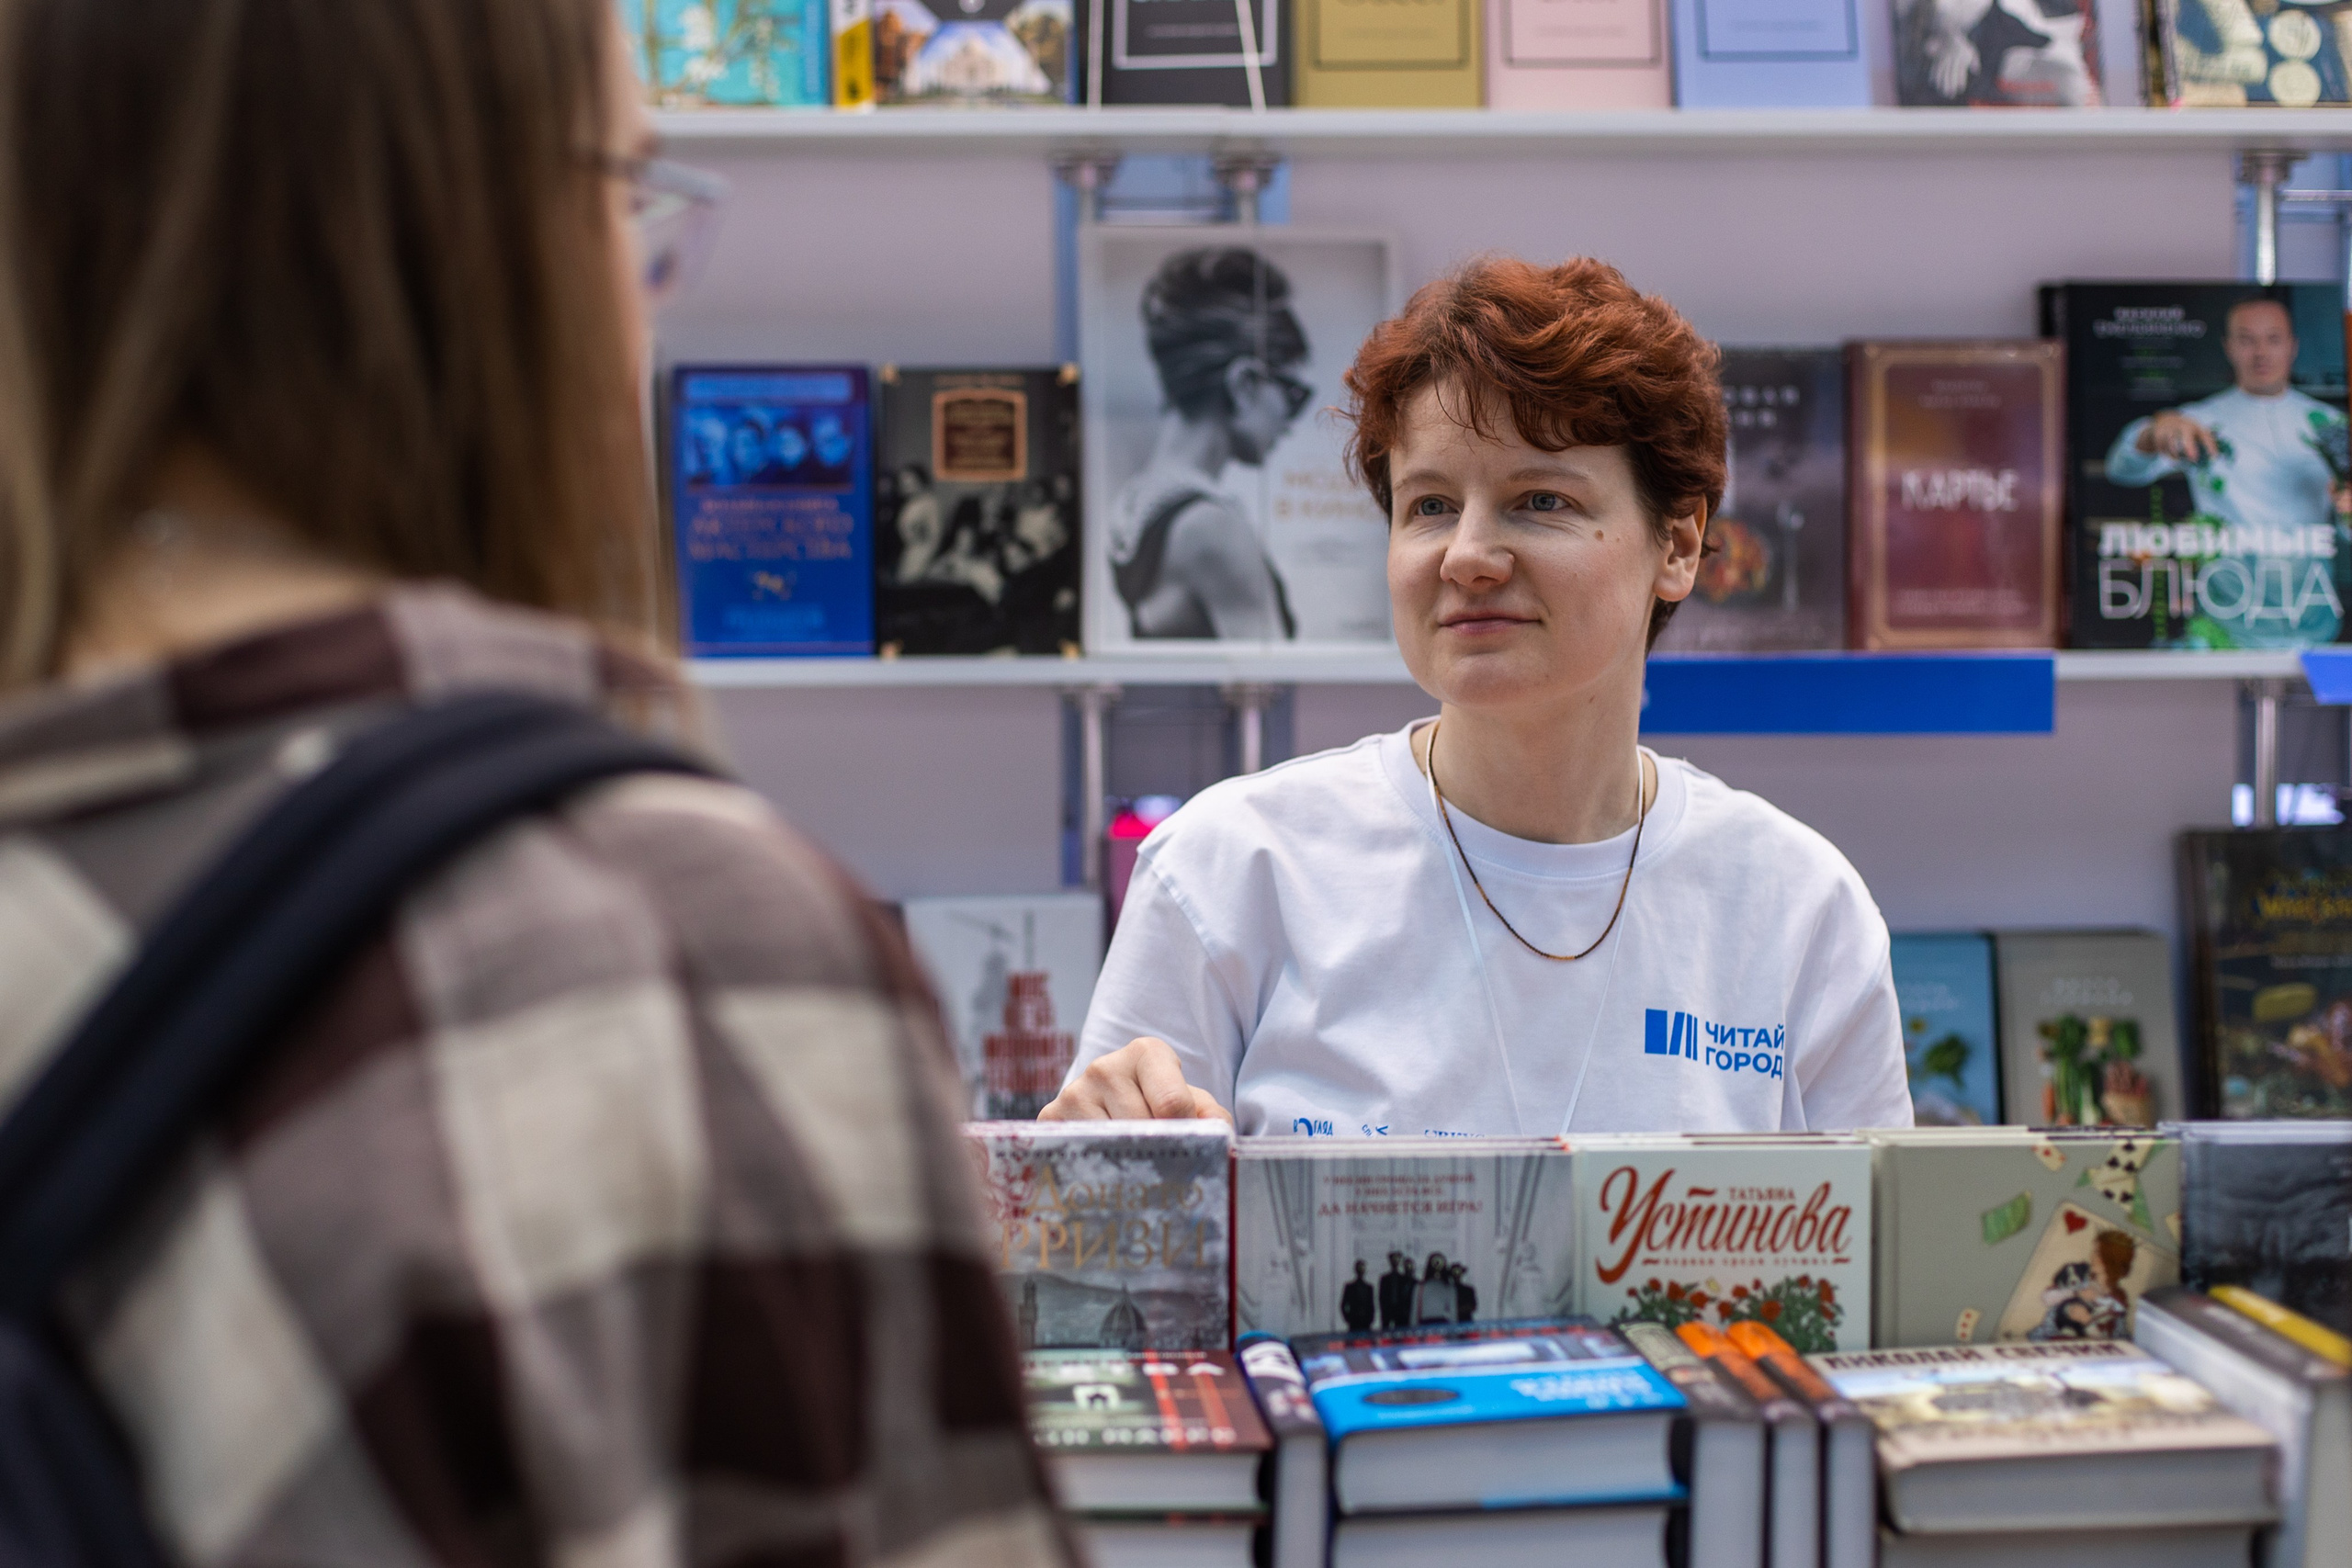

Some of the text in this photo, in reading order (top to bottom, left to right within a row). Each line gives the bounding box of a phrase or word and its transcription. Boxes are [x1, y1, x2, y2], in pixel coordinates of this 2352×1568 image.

[1901, 468, 2020, 513] КАРТЬЕ
[2098, 523, 2338, 558] ЛЮБИМЫЕ
[2098, 558, 2345, 629] БЛЮДА
[1705, 1021, 1784, 1051] ЧИТАЙ
[1705, 1045, 1783, 1080] ГОРОД
[1025, 1165, 1205, 1220] Донато
[1728, 1186, 1796, 1202] ТАТЬЯНА
[1000, 1220, 1212, 1270] РРИЗИ
[1595, 1164, 1853, 1286] Устинова
[1824, 1342, 2125, 1370] НИКОЛАЙ СВЕЧИН
